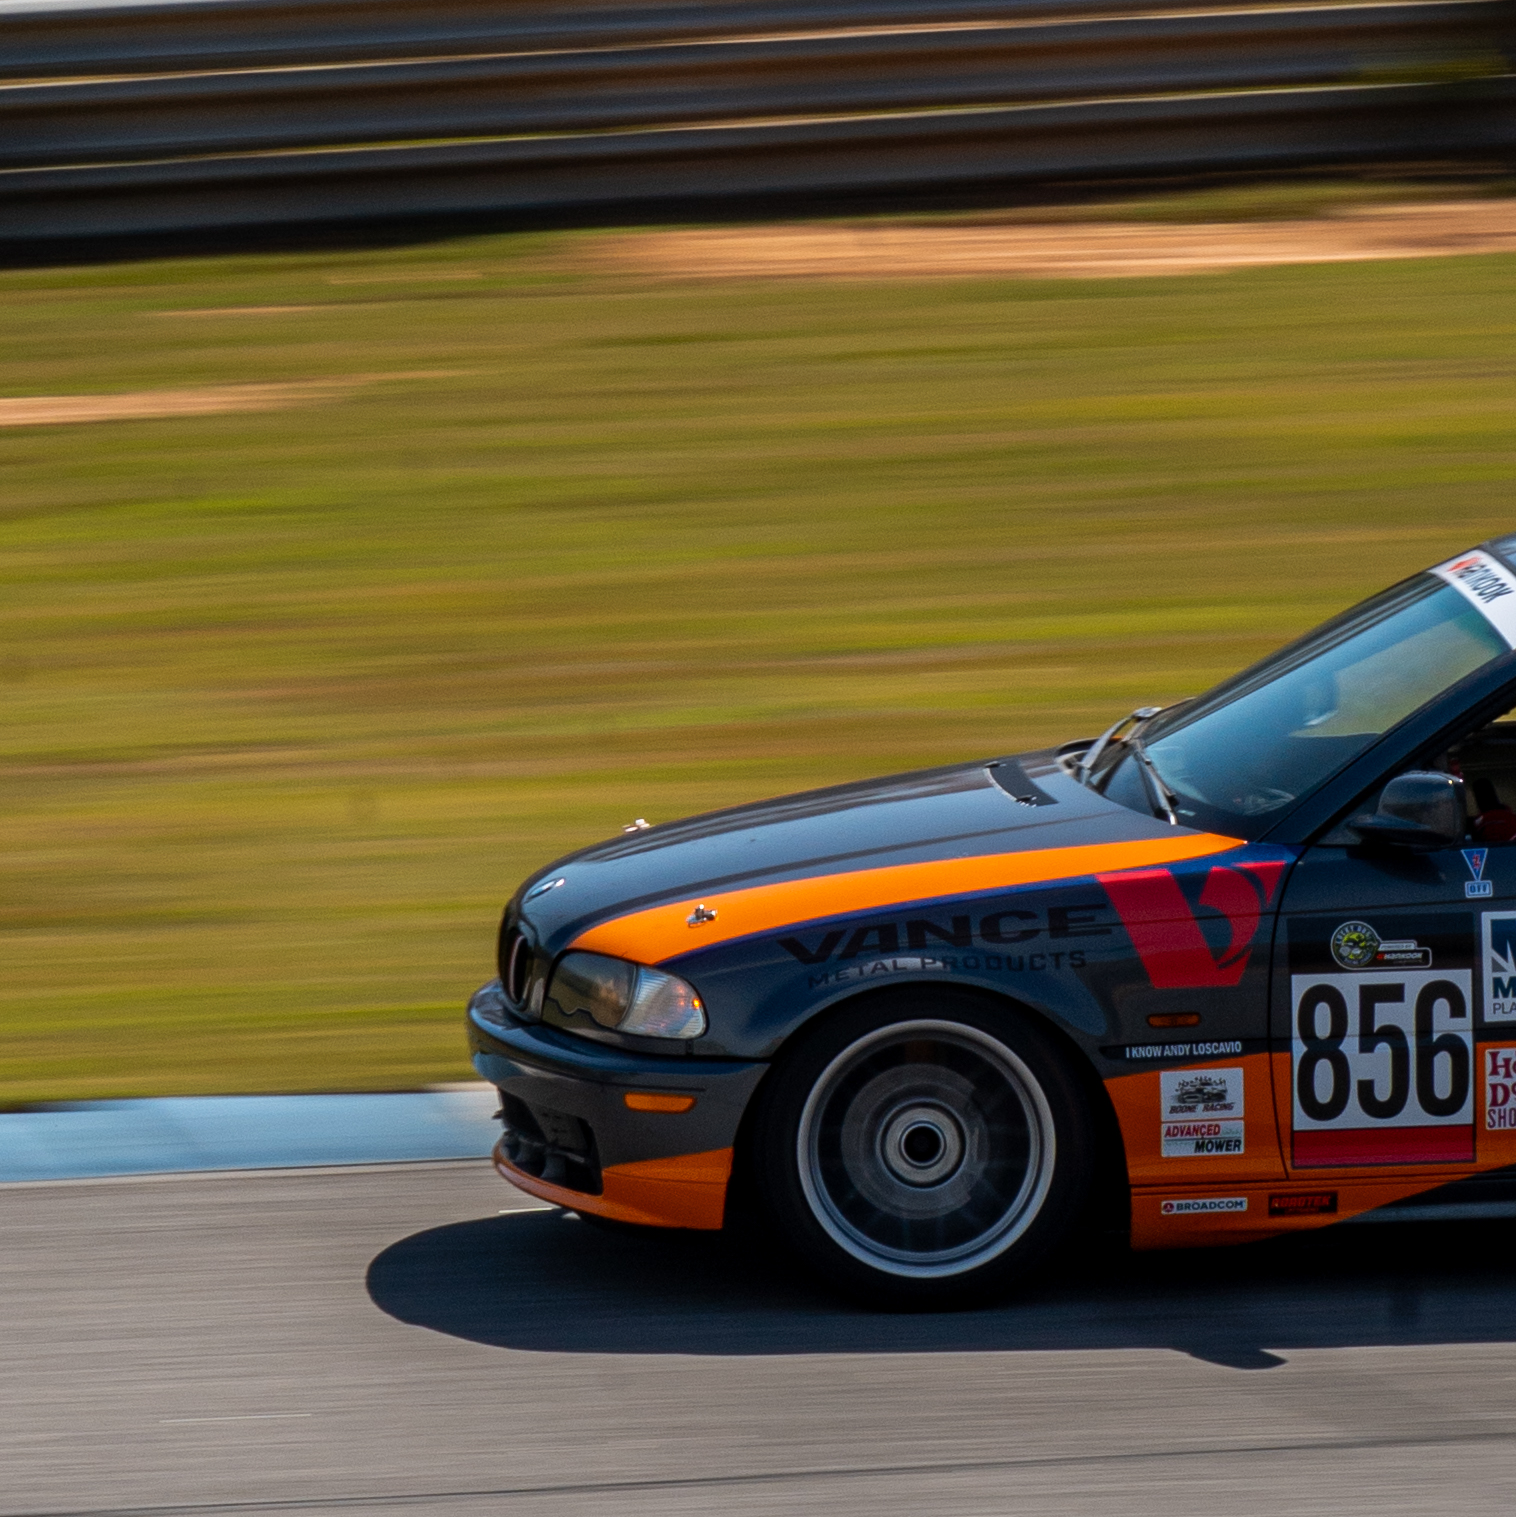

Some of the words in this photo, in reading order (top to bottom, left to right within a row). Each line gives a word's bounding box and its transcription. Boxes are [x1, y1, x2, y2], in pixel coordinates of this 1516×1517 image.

[1469, 883, 1488, 894] OFF
[776, 902, 1112, 965] VANCE
[807, 959, 901, 989] METAL
[918, 949, 1088, 973] PRODUCTS
[1125, 1047, 1130, 1059] I
[1131, 1046, 1163, 1058] KNOW
[1163, 1044, 1191, 1057] ANDY
[1192, 1041, 1242, 1056] LOSCAVIO
[1297, 979, 1470, 1121] 856
[1168, 1104, 1199, 1115] BOONE
[1201, 1101, 1235, 1113] RACING
[1164, 1123, 1221, 1138] ADVANCED
[1194, 1139, 1242, 1153] MOWER
[1175, 1199, 1244, 1212] BROADCOM
